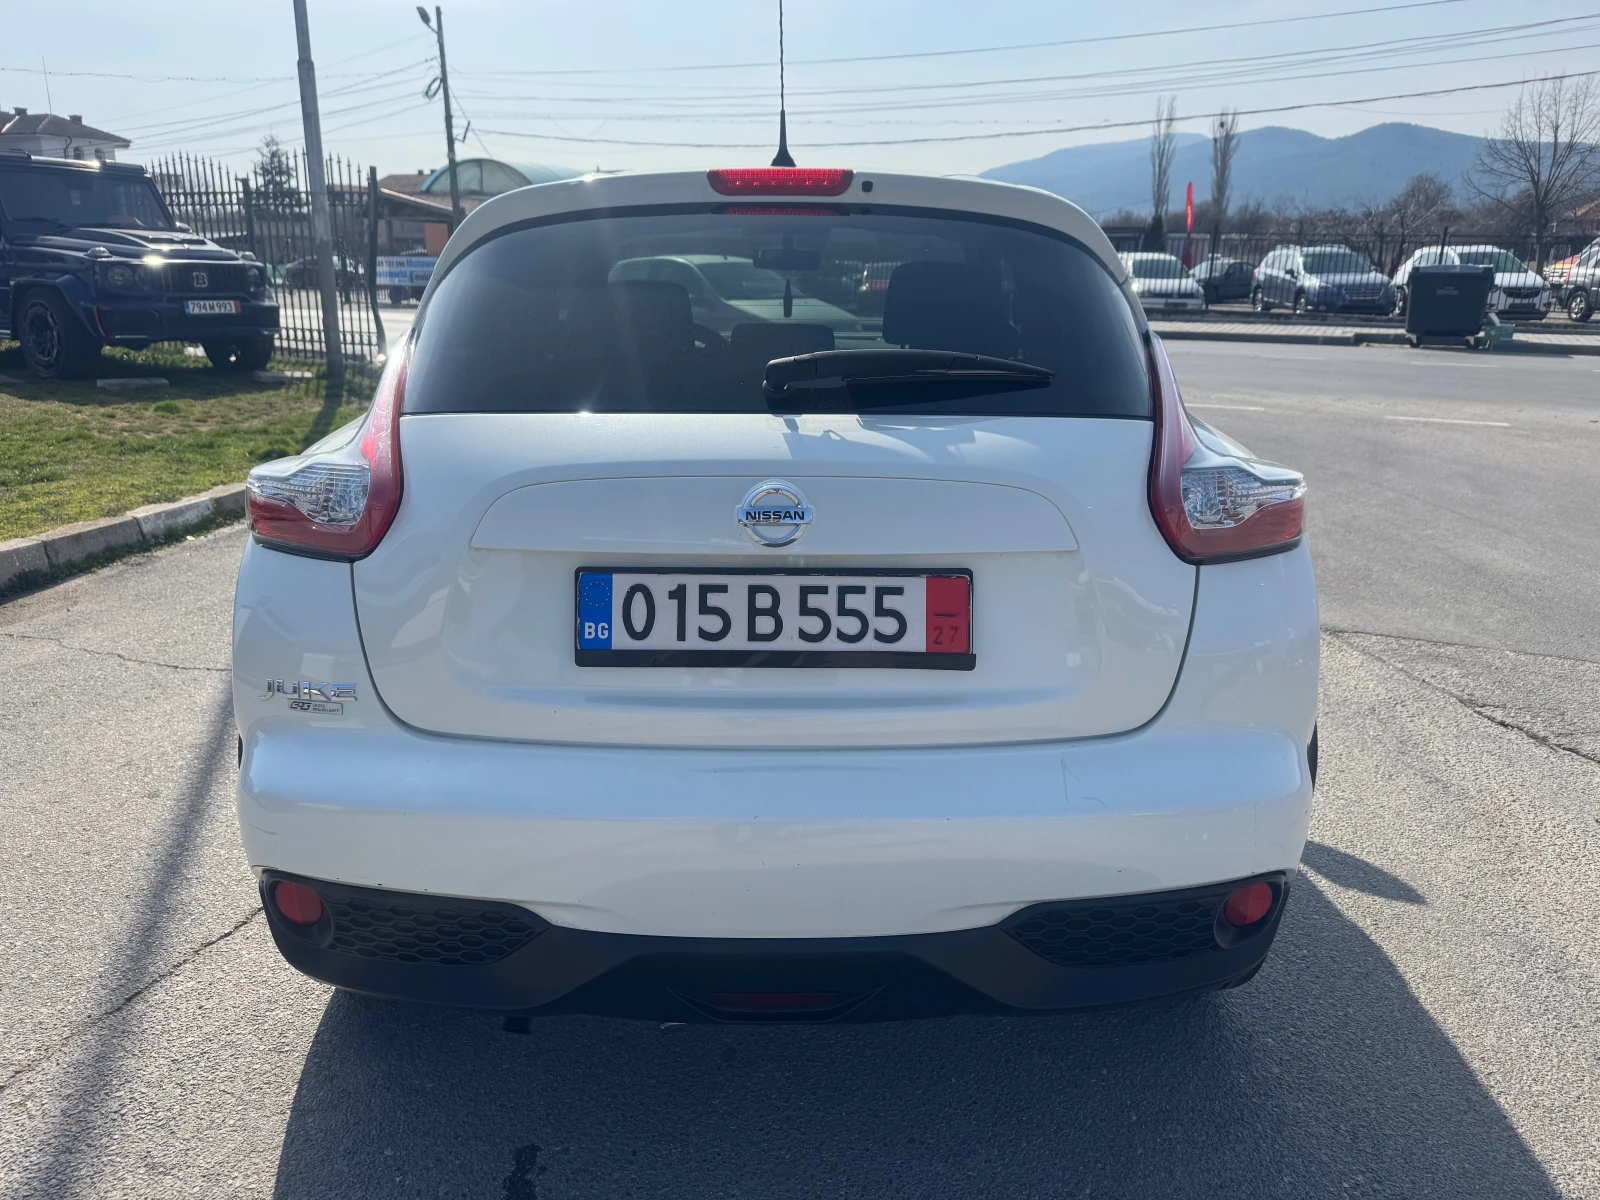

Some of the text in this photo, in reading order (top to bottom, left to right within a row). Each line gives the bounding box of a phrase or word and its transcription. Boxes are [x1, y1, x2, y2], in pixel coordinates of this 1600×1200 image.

[745, 510, 805, 521] NISSAN
[584, 622, 609, 639] BG
[932, 625, 958, 645] 27
[259, 678, 357, 701] JUKE
